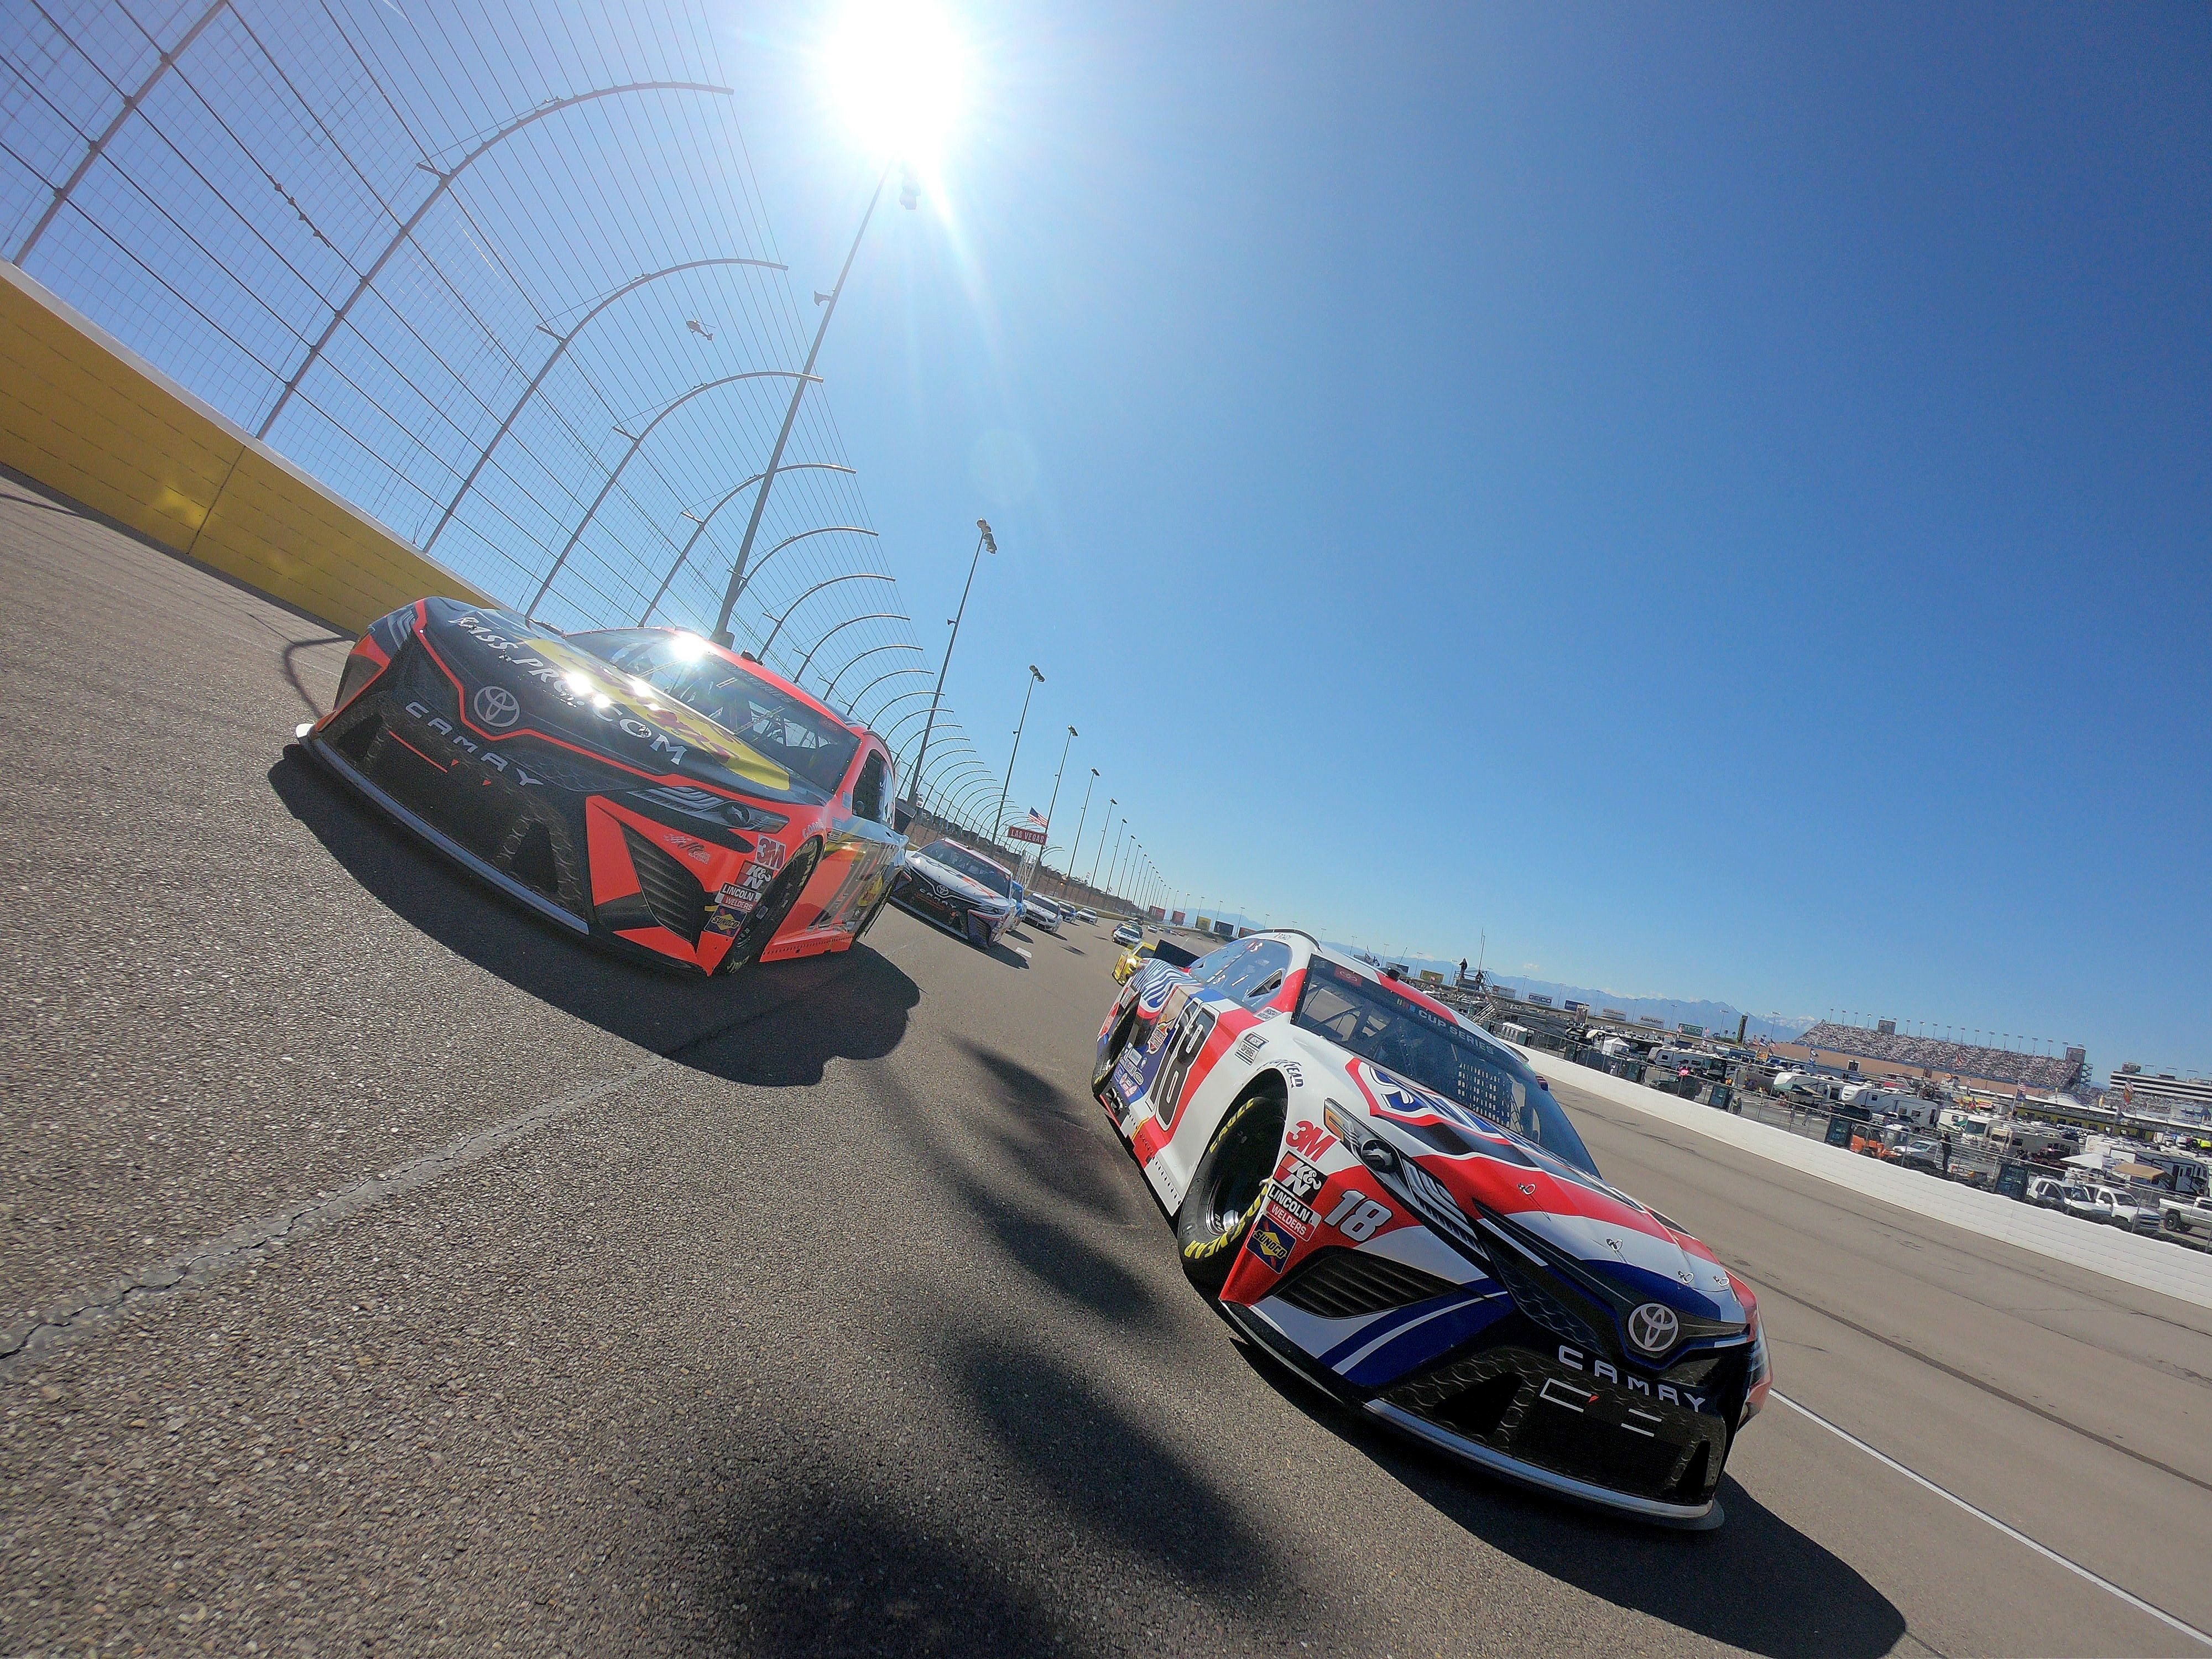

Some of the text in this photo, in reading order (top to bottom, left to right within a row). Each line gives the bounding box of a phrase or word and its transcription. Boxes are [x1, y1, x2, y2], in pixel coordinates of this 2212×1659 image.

[1011, 829, 1044, 843] LAS VEGAS
[757, 837, 785, 870] 3M
[722, 884, 754, 901] LINCOLN
[725, 896, 753, 910] WELDERS
[712, 916, 739, 928] SUNOCO
[1418, 1009, 1494, 1055] CUP SERIES
[1145, 997, 1220, 1131] 18
[1285, 1120, 1338, 1163] 3M
[1269, 1186, 1311, 1222] LINCOLN
[1271, 1204, 1306, 1235] WELDERS
[1324, 1190, 1393, 1242] 18
[1254, 1230, 1288, 1258] SUNOCO
[1558, 1345, 1705, 1413] CAMRY
